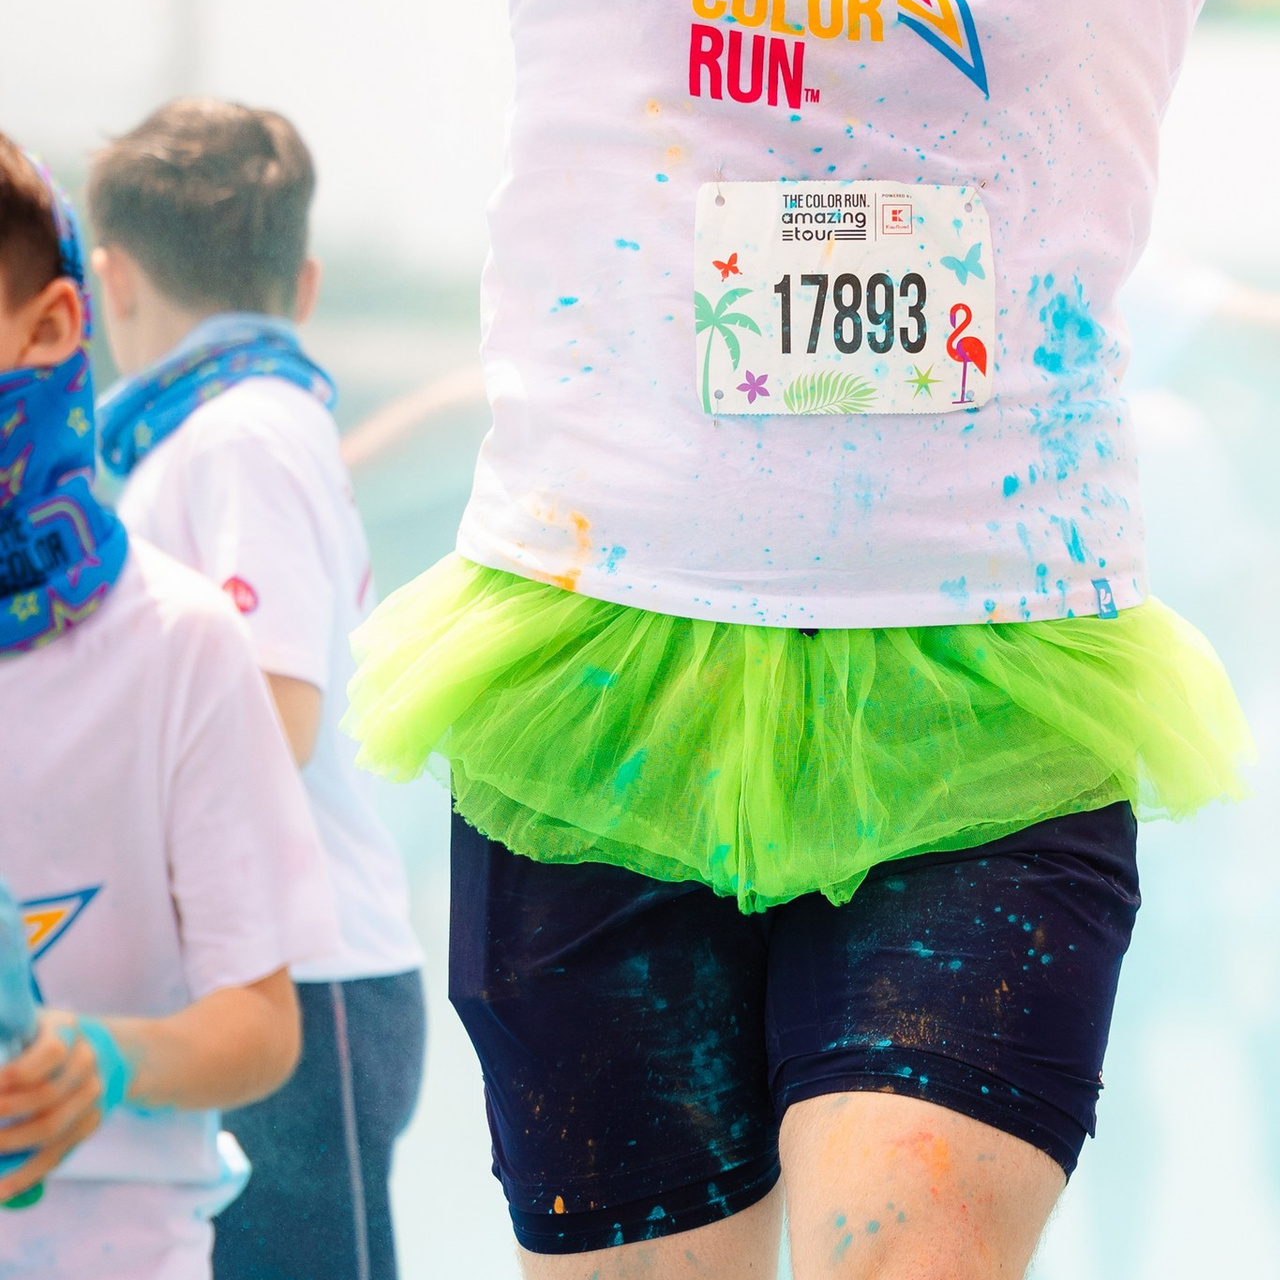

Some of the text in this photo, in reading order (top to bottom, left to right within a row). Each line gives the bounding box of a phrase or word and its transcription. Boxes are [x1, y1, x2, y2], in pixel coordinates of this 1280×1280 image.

[688, 22, 806, 110] RUN
[782, 194, 804, 209] THE
[805, 193, 842, 209] COLOR
[781, 208, 867, 229] amazing
[795, 226, 833, 241] tour
[773, 272, 927, 355] 17893
